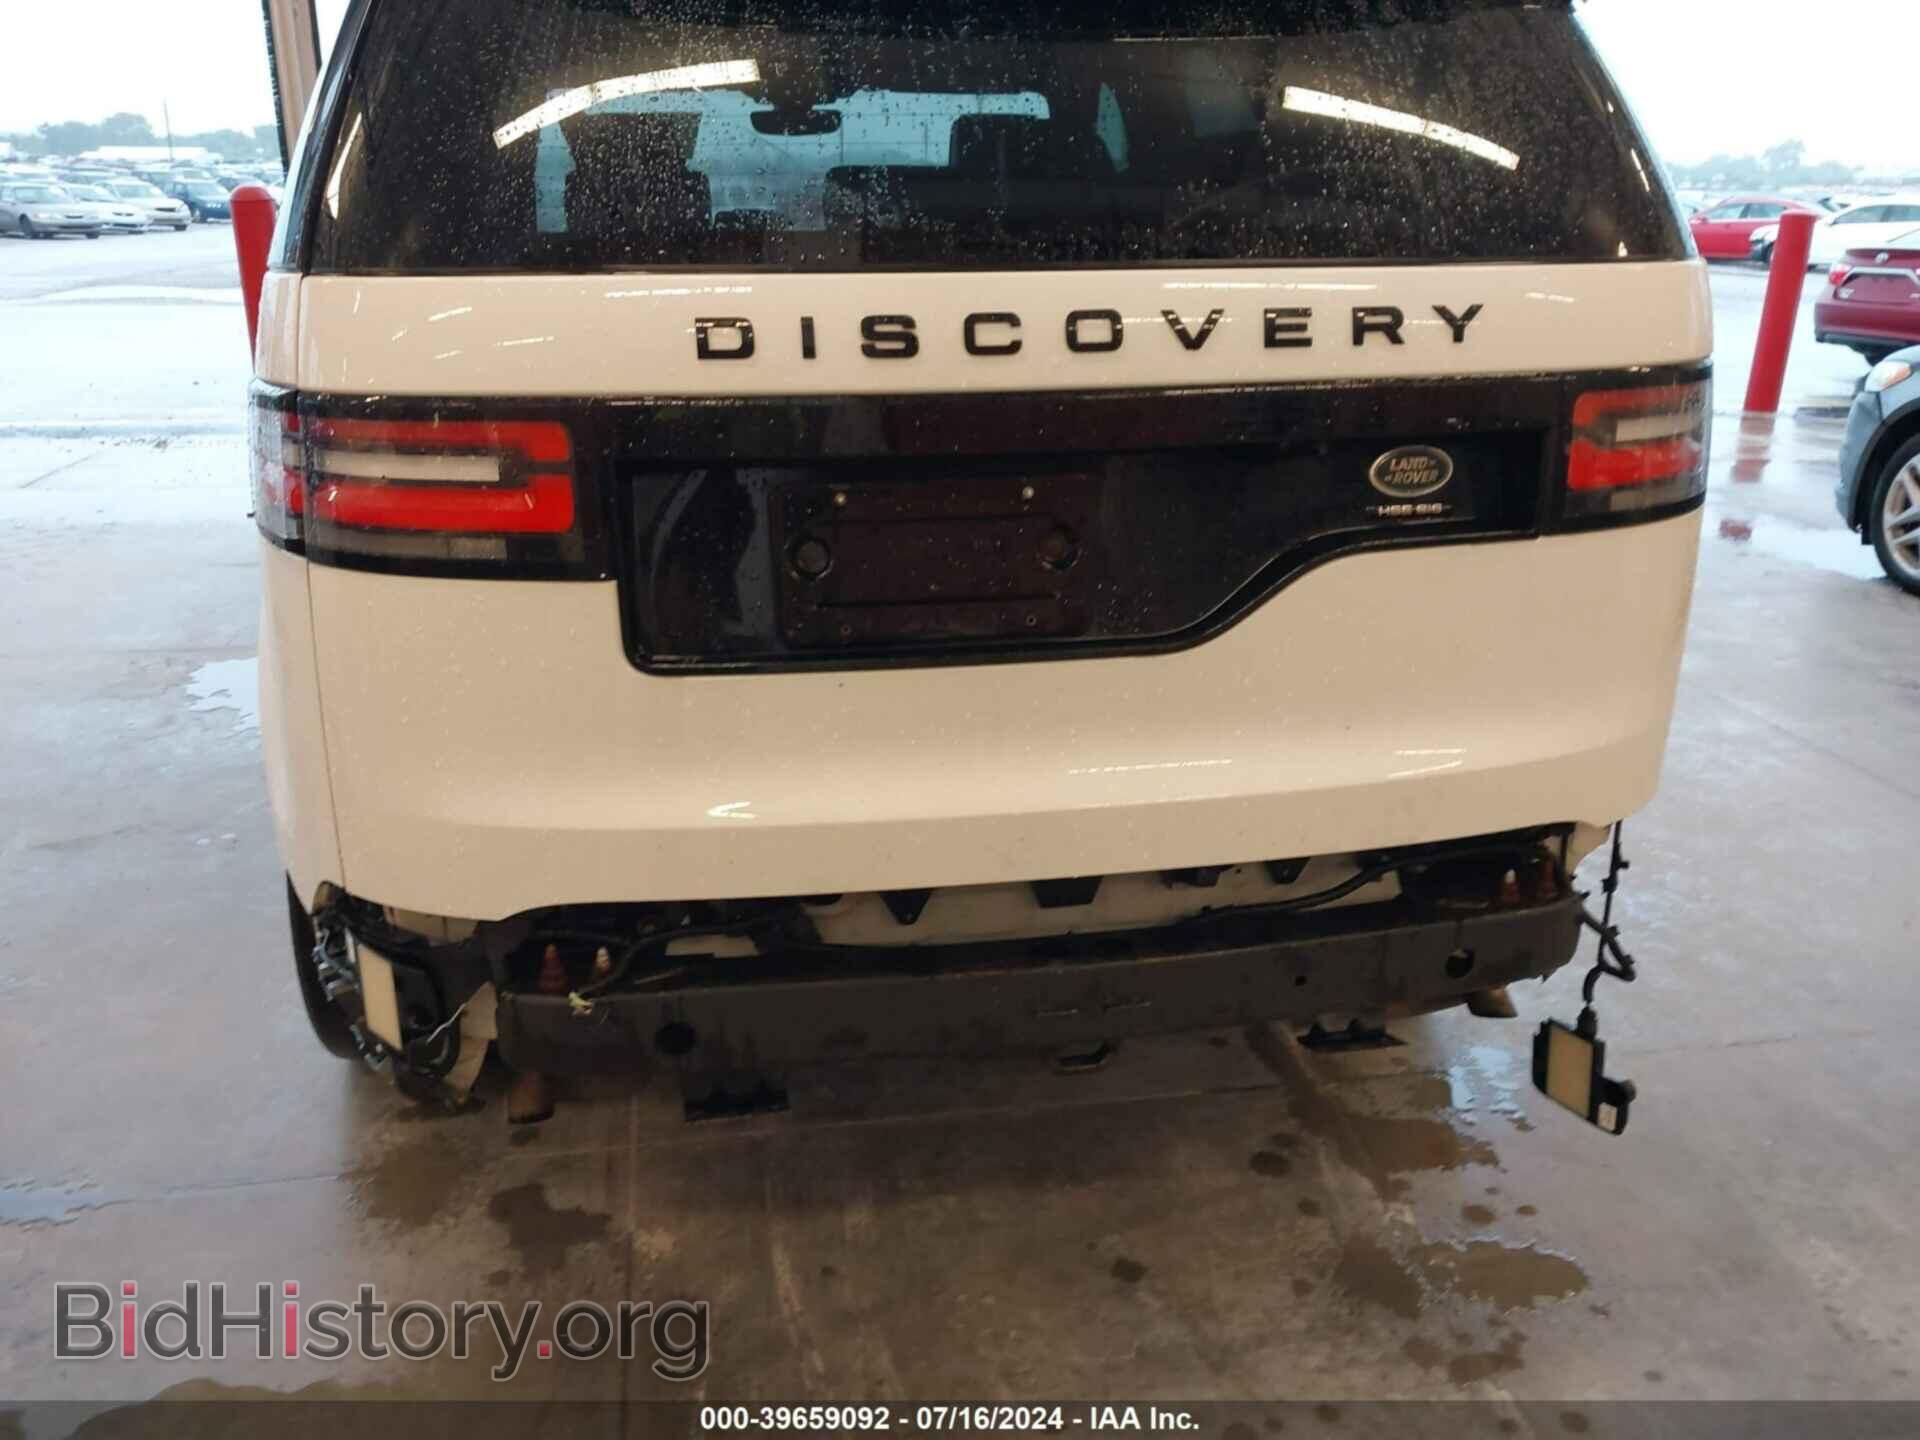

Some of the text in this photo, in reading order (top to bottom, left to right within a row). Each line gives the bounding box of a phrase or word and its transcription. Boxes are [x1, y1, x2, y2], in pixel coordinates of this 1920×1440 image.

[695, 303, 1484, 360] DISCOVERY
[1391, 456, 1429, 471] LAND
[1391, 470, 1440, 484] ROVER
